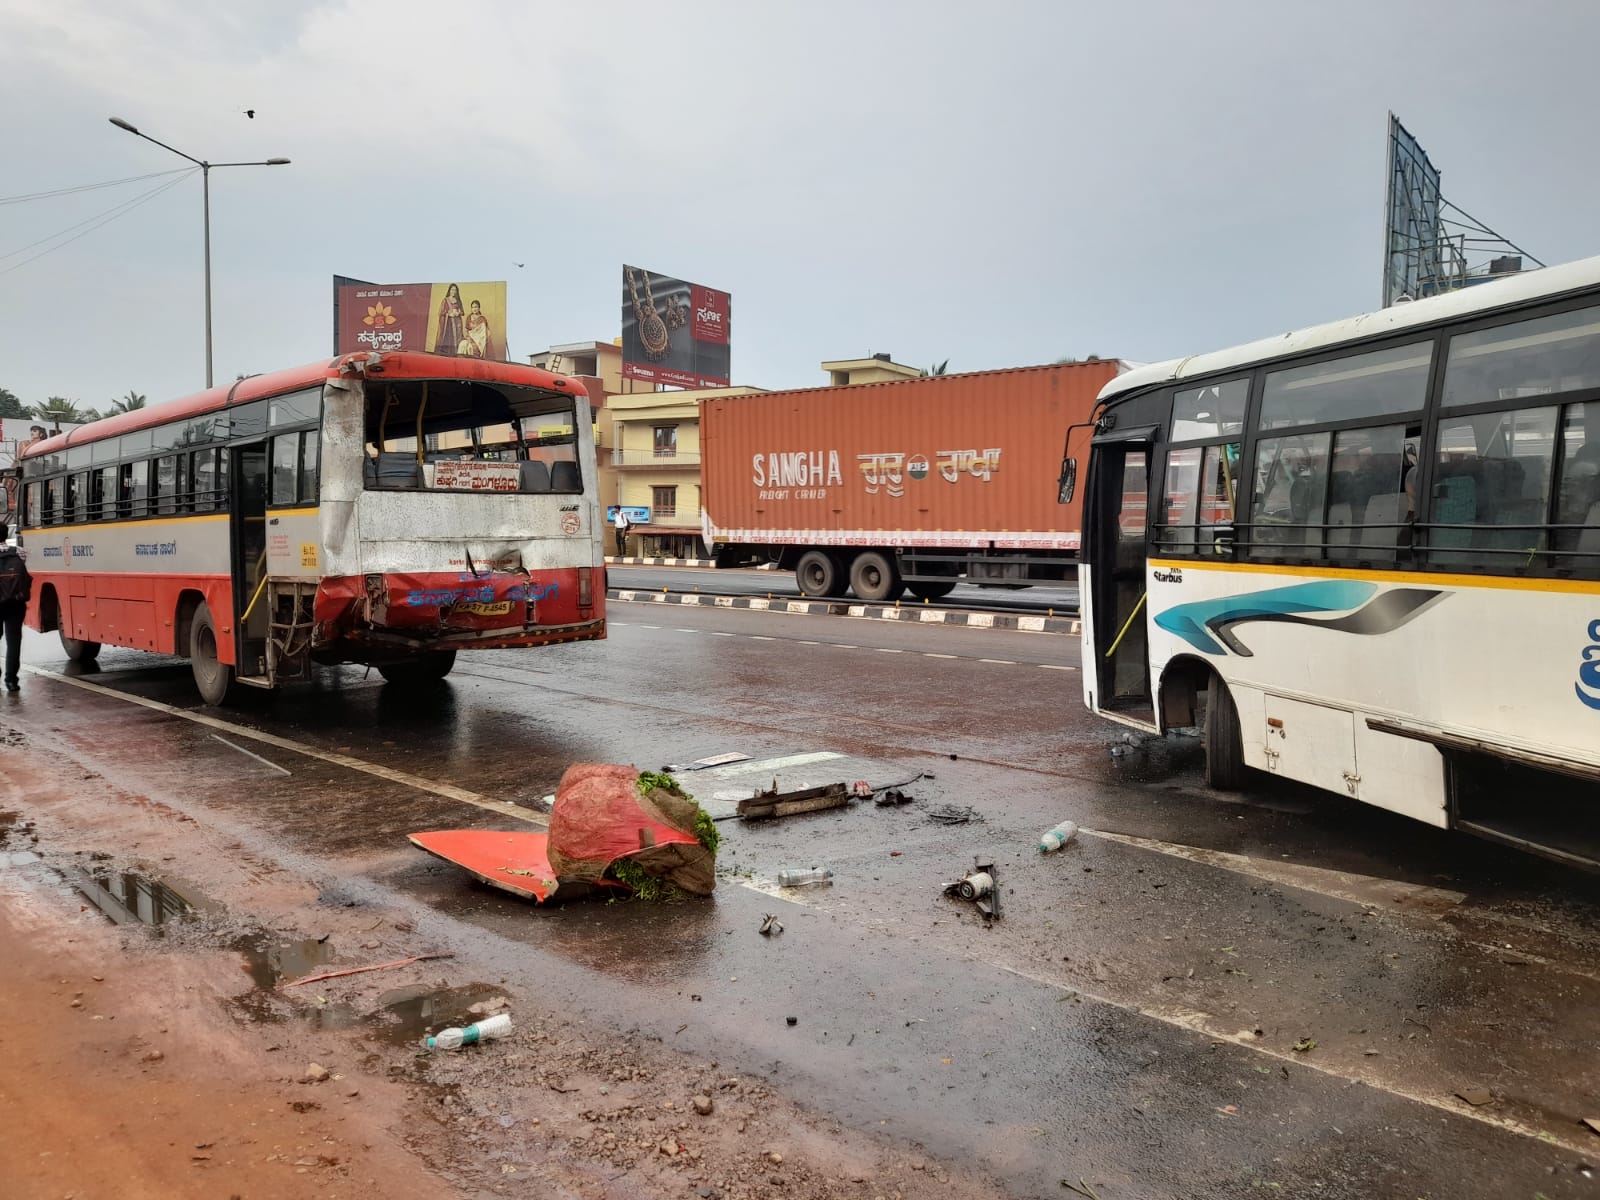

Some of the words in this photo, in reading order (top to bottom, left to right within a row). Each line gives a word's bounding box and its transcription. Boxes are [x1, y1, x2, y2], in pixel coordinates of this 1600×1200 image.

[357, 329, 403, 349] ಸತ್ಯನಾಥ
[752, 449, 843, 488] SANGHA
[72, 545, 94, 557] KSRTC
[1153, 570, 1183, 583] Starbus
